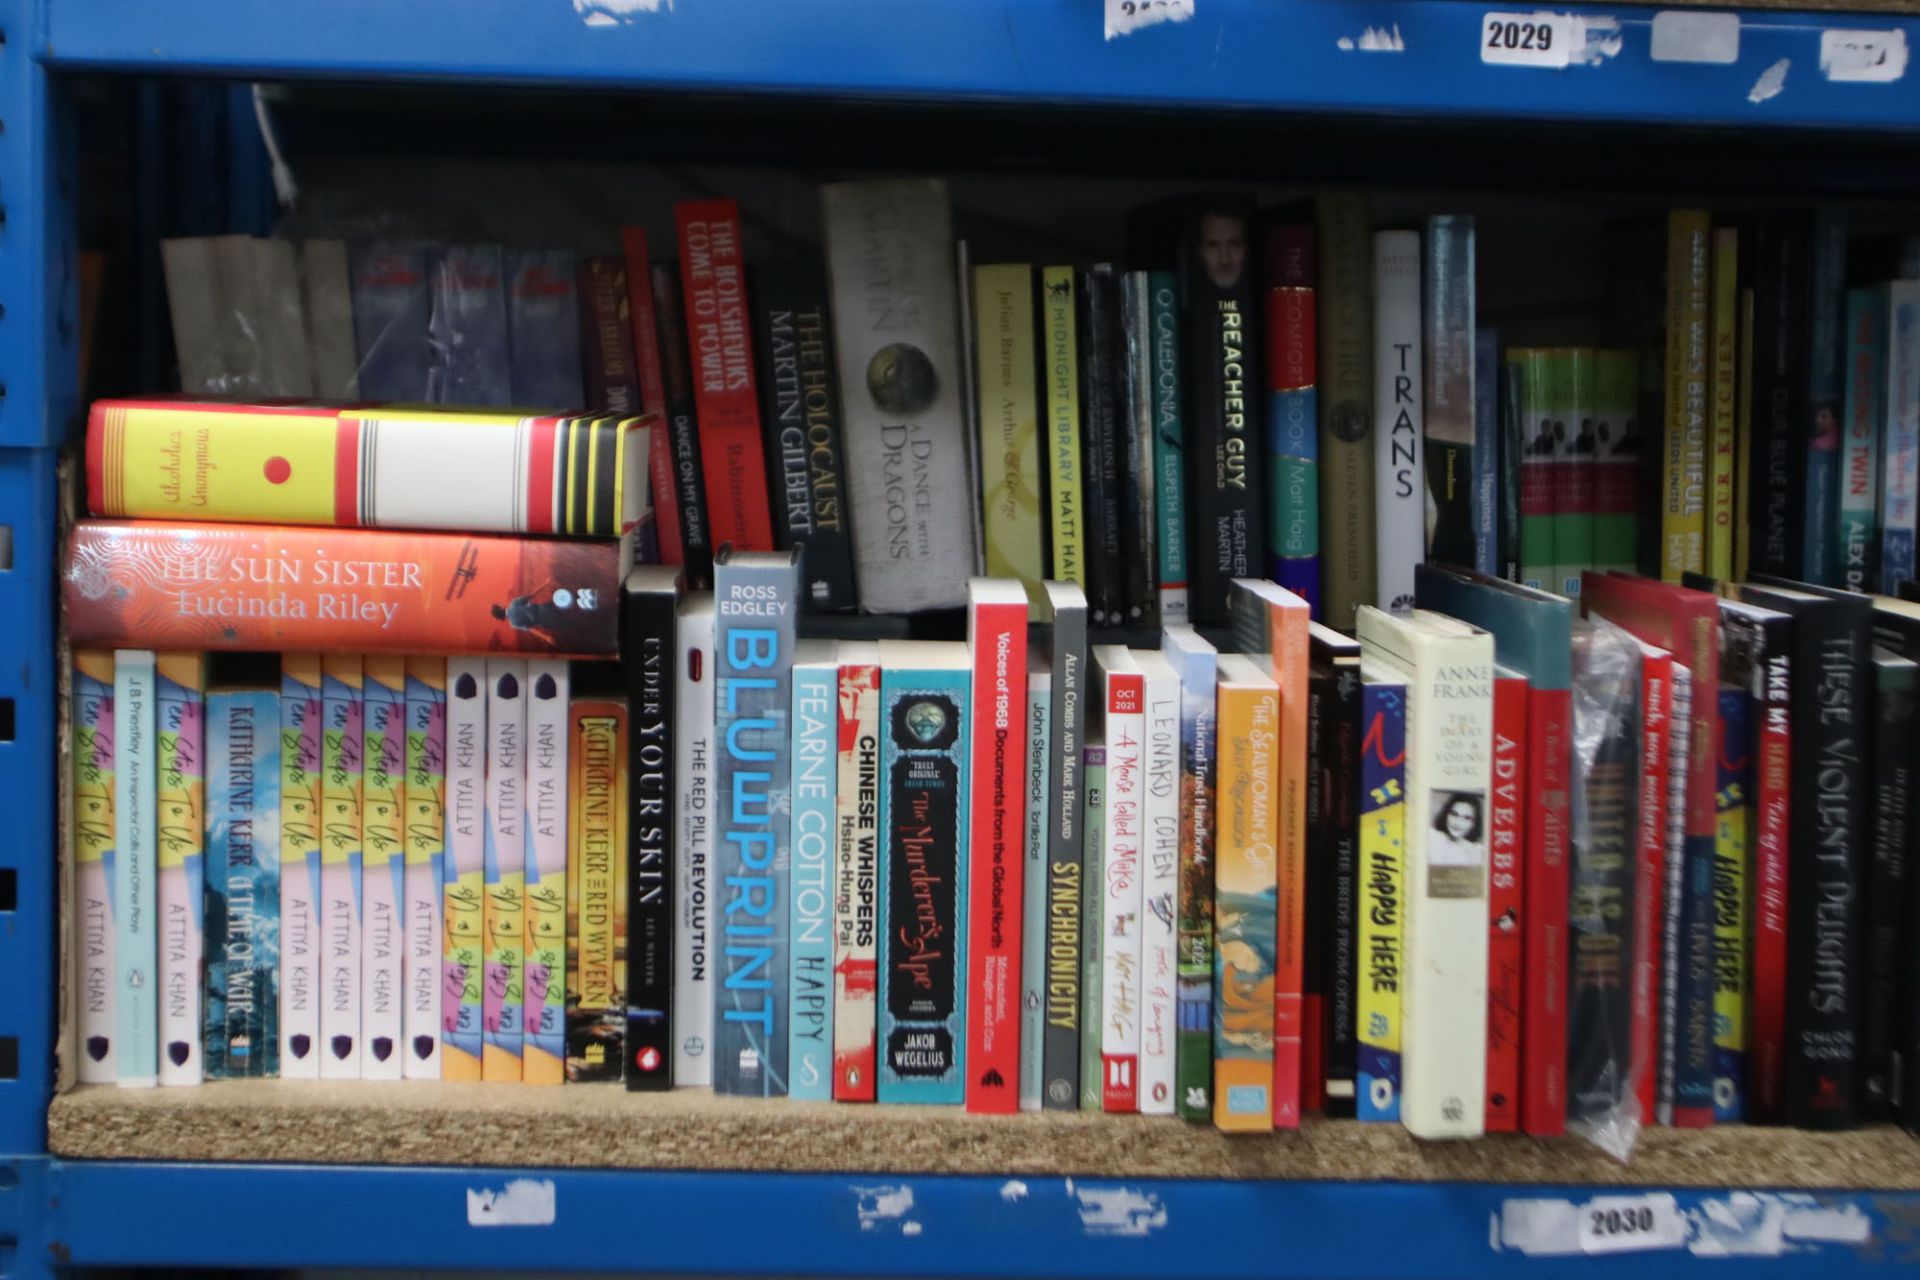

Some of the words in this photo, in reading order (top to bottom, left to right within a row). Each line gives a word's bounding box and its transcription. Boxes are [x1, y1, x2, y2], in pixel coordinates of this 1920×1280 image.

[1488, 22, 1553, 51] 2029
[687, 221, 713, 279] COME
[711, 219, 737, 257] THE
[693, 287, 715, 315] TO
[1156, 288, 1173, 307] O
[1218, 301, 1238, 310] THE
[715, 265, 749, 390] BOLSHEVIKS
[797, 306, 827, 362] THE
[697, 323, 724, 392] POWER
[768, 309, 802, 421] MARTIN
[1053, 308, 1070, 402] MIDNIGHT
[1157, 312, 1175, 427] CALEDONIA
[1223, 312, 1244, 428] REACHER
[1716, 334, 1731, 454] KITCHEN
[674, 415, 693, 459] DANCE
[1058, 406, 1073, 482] LIBRARY
[1287, 397, 1305, 450] BOOK
[1391, 344, 1416, 498] TRANS
[160, 428, 182, 503] Alcoholics
[192, 427, 217, 507] Anonymous
[680, 461, 694, 482] ON
[803, 370, 841, 533] HOLOCAUST
[1226, 438, 1246, 489] GUY
[1669, 431, 1680, 465] LEEDS
[1684, 381, 1704, 516] BEAUTIFUL
[1770, 439, 1788, 485] BLUE
[1850, 446, 1870, 496] TWIN
[683, 485, 697, 504] MY
[780, 426, 813, 536] GILBERT
[879, 424, 910, 559] DRAGONS
[910, 439, 932, 514] DANCE
[1164, 455, 1179, 512] ELSPETH
[1290, 465, 1306, 505] Matt
[1447, 449, 1458, 500] Downham
[1669, 469, 1680, 513] UNITED
[1060, 490, 1075, 538] MATT
[1484, 473, 1495, 533] Happiness
[1717, 474, 1730, 527] OUR
[685, 506, 703, 545] GRAVE
[1166, 518, 1182, 572] BARKER
[1217, 516, 1232, 571] MARTIN
[1233, 509, 1247, 577] HEATHER
[1286, 508, 1305, 550] Haig
[1768, 493, 1786, 562] PLANET
[1847, 521, 1865, 564] ALEX
[161, 555, 221, 581] THE
[229, 553, 303, 585] SUN
[313, 555, 423, 589] SISTER
[1669, 533, 1682, 570] HAY
[1687, 532, 1700, 569] PHIL
[178, 589, 307, 619] Lucinda
[316, 594, 400, 630] Riley
[720, 601, 788, 615] EDGLEY
[731, 585, 777, 599] ROSS
[643, 637, 661, 715] UNDER
[996, 632, 1011, 678] Voices
[1064, 653, 1078, 688] ALLAN
[1434, 667, 1490, 681] ANNE
[1768, 655, 1790, 701] TAKE
[1117, 690, 1136, 699] OCT
[1433, 683, 1492, 698] FRANK
[1647, 678, 1666, 726] munch,
[1817, 634, 1856, 727] THESE
[128, 701, 142, 755] Priestley
[995, 692, 1009, 728] 1968
[1032, 702, 1046, 735] John
[1064, 691, 1077, 729] COMBS
[1115, 701, 1136, 710] 2021
[1251, 696, 1276, 726] THE
[1449, 713, 1477, 724] THE
[1766, 707, 1789, 735] MY
[228, 706, 254, 812] KATHARINE
[457, 723, 473, 768] KHAN
[499, 723, 515, 768] KHAN
[538, 724, 555, 769] KHAN
[692, 737, 706, 771] THE
[798, 683, 828, 798] FEARNE
[1064, 731, 1075, 752] AND
[1114, 725, 1138, 748] A
[1150, 700, 1176, 799] LEONARD
[1194, 709, 1209, 762] National
[1646, 731, 1663, 771] move,
[586, 721, 609, 822] KATHARINE
[639, 721, 664, 816] YOUR
[858, 734, 876, 829] CHINESE
[994, 729, 1009, 806] Documents
[1031, 738, 1046, 803] Steinbeck
[1062, 755, 1076, 788] MARK
[1111, 756, 1138, 794] Mouse
[1194, 764, 1208, 793] Trust
[1250, 730, 1274, 840] SEALWOMAN'S
[1766, 743, 1788, 790] HAND
[127, 777, 142, 825] Inspector
[457, 778, 473, 836] ATTIYA
[499, 778, 515, 835] ATTIYA
[538, 778, 555, 836] ATTIYA
[692, 777, 706, 810] RED
[911, 791, 930, 822] The
[1061, 790, 1075, 840] HOLLAND
[1494, 733, 1517, 889] ADVERBS
[1816, 738, 1861, 869] VIOLENT
[227, 820, 254, 867] KERR
[692, 815, 706, 847] PILL
[723, 628, 778, 1037] BLUEPRINT
[993, 809, 1006, 841] from
[1029, 810, 1042, 841] Tortilla
[1111, 801, 1137, 838] Called
[1193, 799, 1208, 864] Handbook
[585, 828, 609, 873] KERR
[640, 826, 663, 905] SKIN
[838, 815, 855, 915] Hsiao-Hung
[992, 843, 1005, 864] the
[1153, 816, 1177, 880] COHEN
[1336, 838, 1350, 870] THE
[129, 875, 142, 904] Other
[796, 810, 827, 943] COTTON
[856, 836, 875, 948] WHISPERS
[900, 826, 943, 938] Murderer's
[990, 866, 1005, 909] Global
[1336, 875, 1350, 924] BRIDE
[1367, 852, 1398, 927] Happy
[88, 900, 105, 958] ATTIYA
[127, 907, 142, 933] Plays
[291, 900, 308, 956] ATTIYA
[334, 900, 349, 958] ATTIYA
[374, 902, 390, 959] ATTIYA
[416, 900, 432, 957] ATTIYA
[585, 891, 608, 926] RED
[691, 852, 706, 982] REVOLUTION
[839, 919, 854, 946] Pai
[990, 911, 1004, 948] North
[169, 904, 186, 962] ATTIYA
[1049, 862, 1079, 1031] SYNCHRONICITY
[1336, 928, 1350, 978] FROM
[1809, 878, 1852, 1013] DELIGHTS
[584, 930, 608, 1004] WYVERN
[1369, 935, 1398, 993] HERE
[1714, 936, 1740, 993] HERE
[88, 967, 105, 1012] KHAN
[169, 972, 186, 1018] KHAN
[227, 969, 255, 1015] WAR
[291, 966, 308, 1011] KHAN
[334, 967, 349, 1012] KHAN
[374, 969, 390, 1014] KHAN
[416, 967, 432, 1012] KHAN
[795, 956, 825, 1044] HAPPY
[1335, 980, 1349, 1041] ODESSA
[895, 1050, 945, 1068] WEGELIUS
[904, 1033, 936, 1048] JAKOB
[1591, 1207, 1653, 1235] 2030
